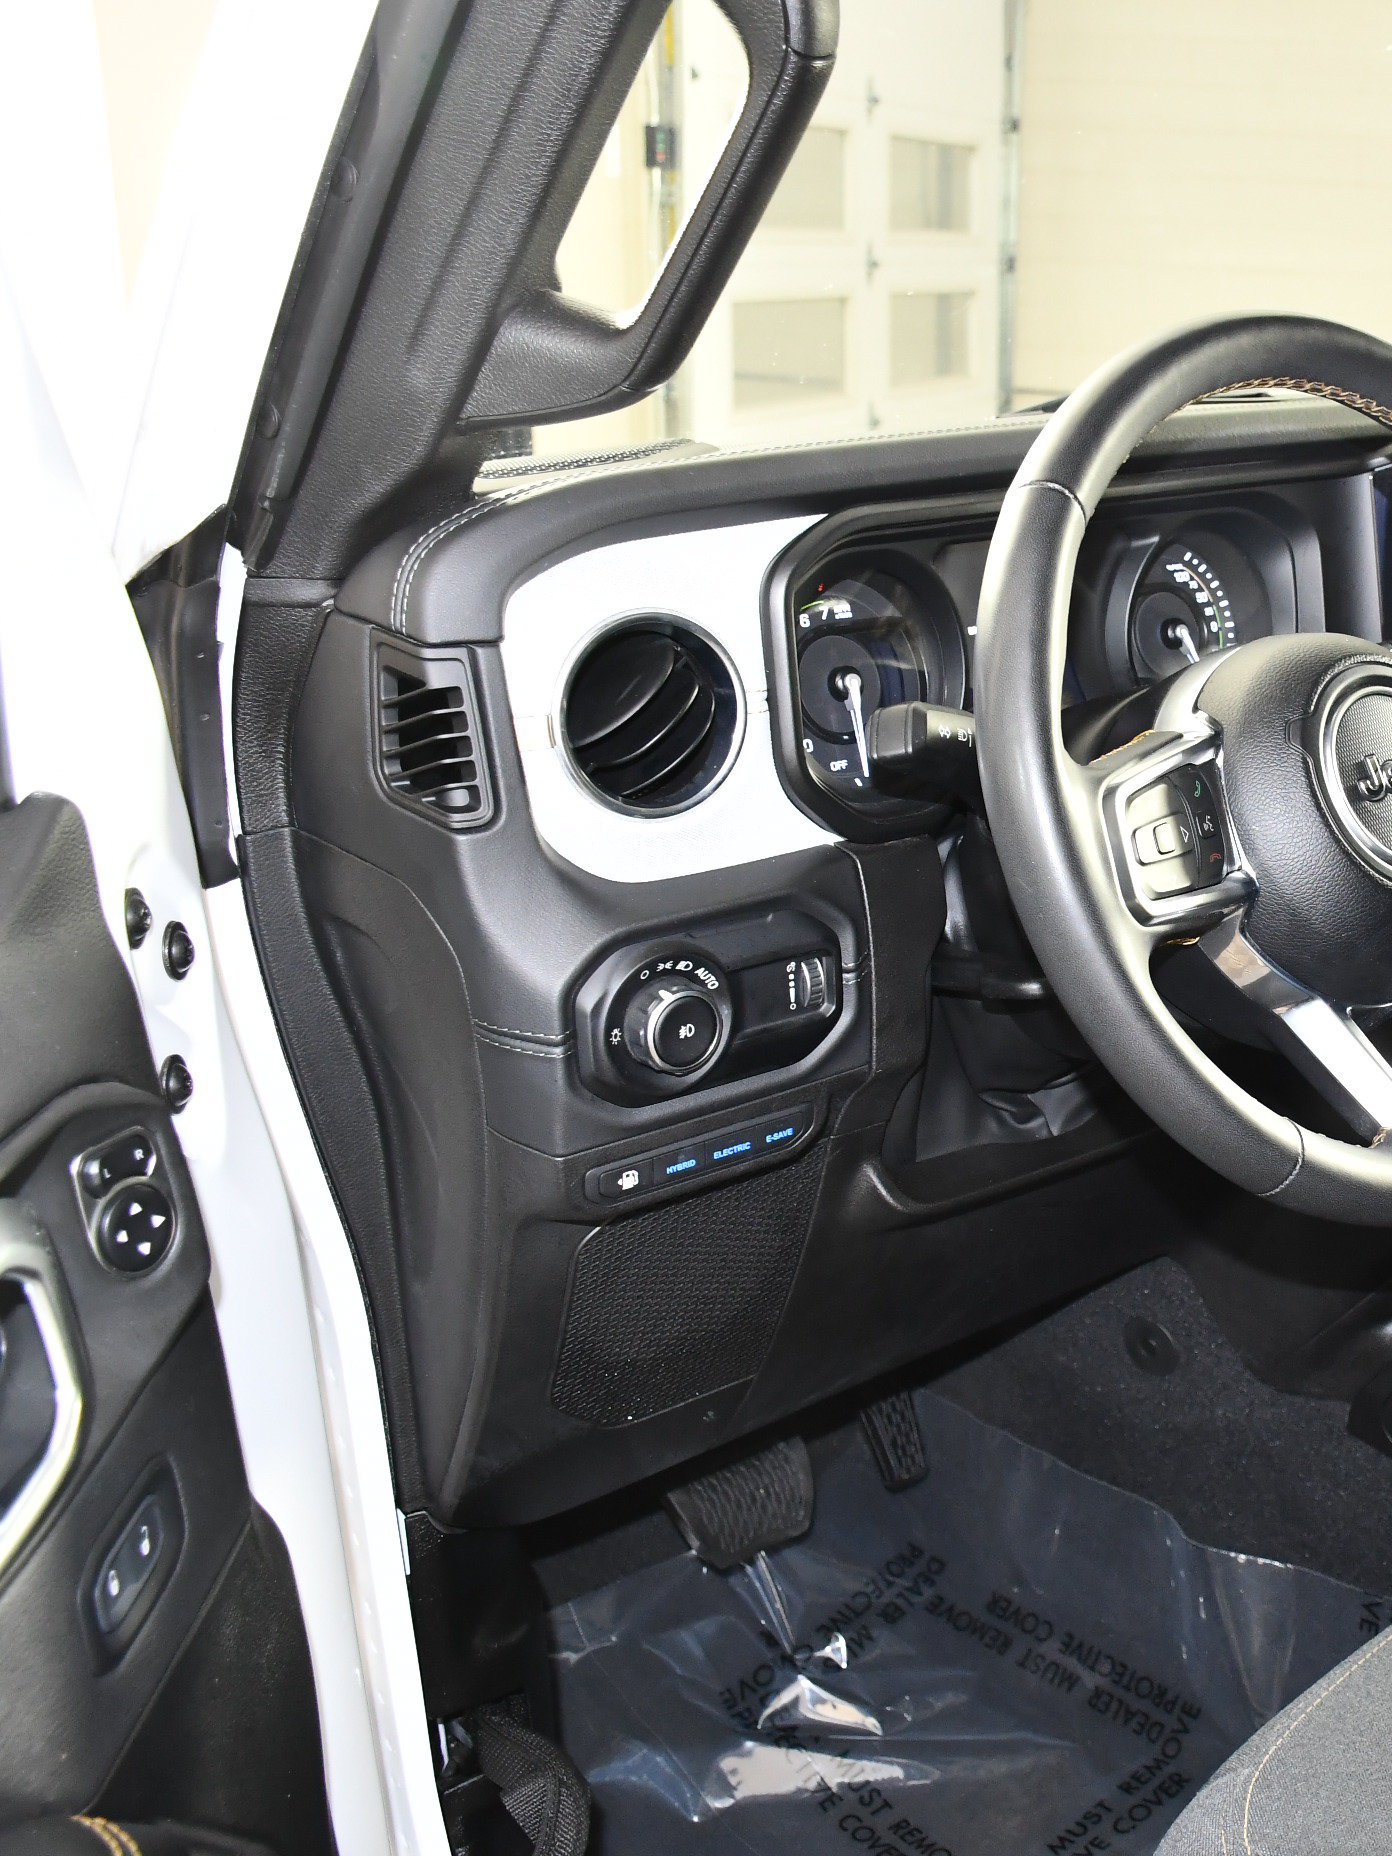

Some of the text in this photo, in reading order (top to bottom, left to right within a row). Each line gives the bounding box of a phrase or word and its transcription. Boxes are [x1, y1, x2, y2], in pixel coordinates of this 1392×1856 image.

[799, 613, 810, 627] 6
[819, 605, 829, 620] 7
[830, 760, 848, 771] OFF
[694, 967, 720, 990] AUTO
[765, 1127, 794, 1143] E-SAVE
[134, 1148, 144, 1161] R
[713, 1141, 752, 1160] ELECTRIC
[102, 1168, 111, 1178] L
[666, 1158, 697, 1175] HYBRID
[925, 1594, 1013, 1655] REMOVE
[986, 1591, 1180, 1714] PROTECTIVE COVER
[1015, 1649, 1082, 1695] MUST
[1088, 1685, 1165, 1744] DEALER
[1046, 1700, 1202, 1856] MUST REMOVE
[1113, 1772, 1192, 1834] COVER
